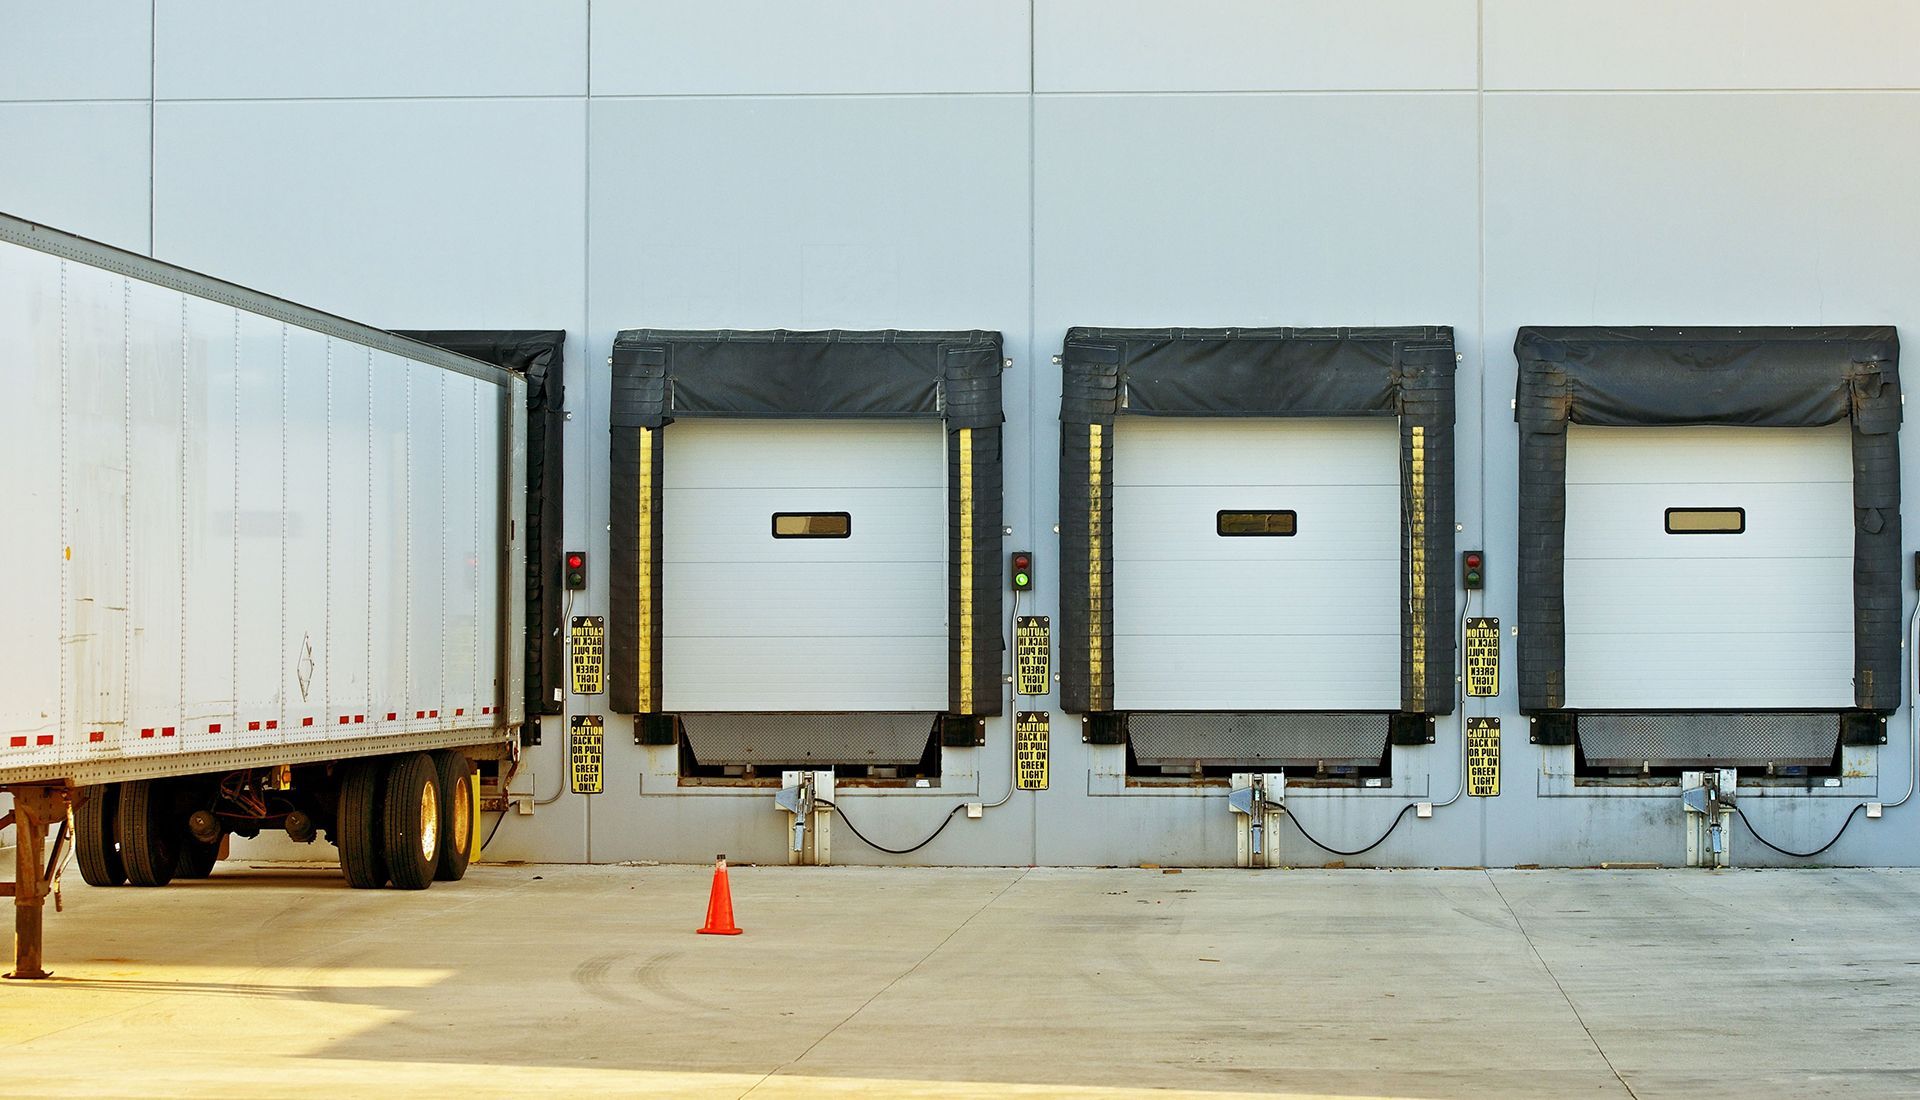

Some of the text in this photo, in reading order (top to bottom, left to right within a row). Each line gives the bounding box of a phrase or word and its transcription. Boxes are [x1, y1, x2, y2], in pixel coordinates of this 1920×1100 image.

[572, 727, 602, 735] CAUTION
[1017, 723, 1048, 731] CAUTION
[1468, 729, 1499, 738] CAUTION
